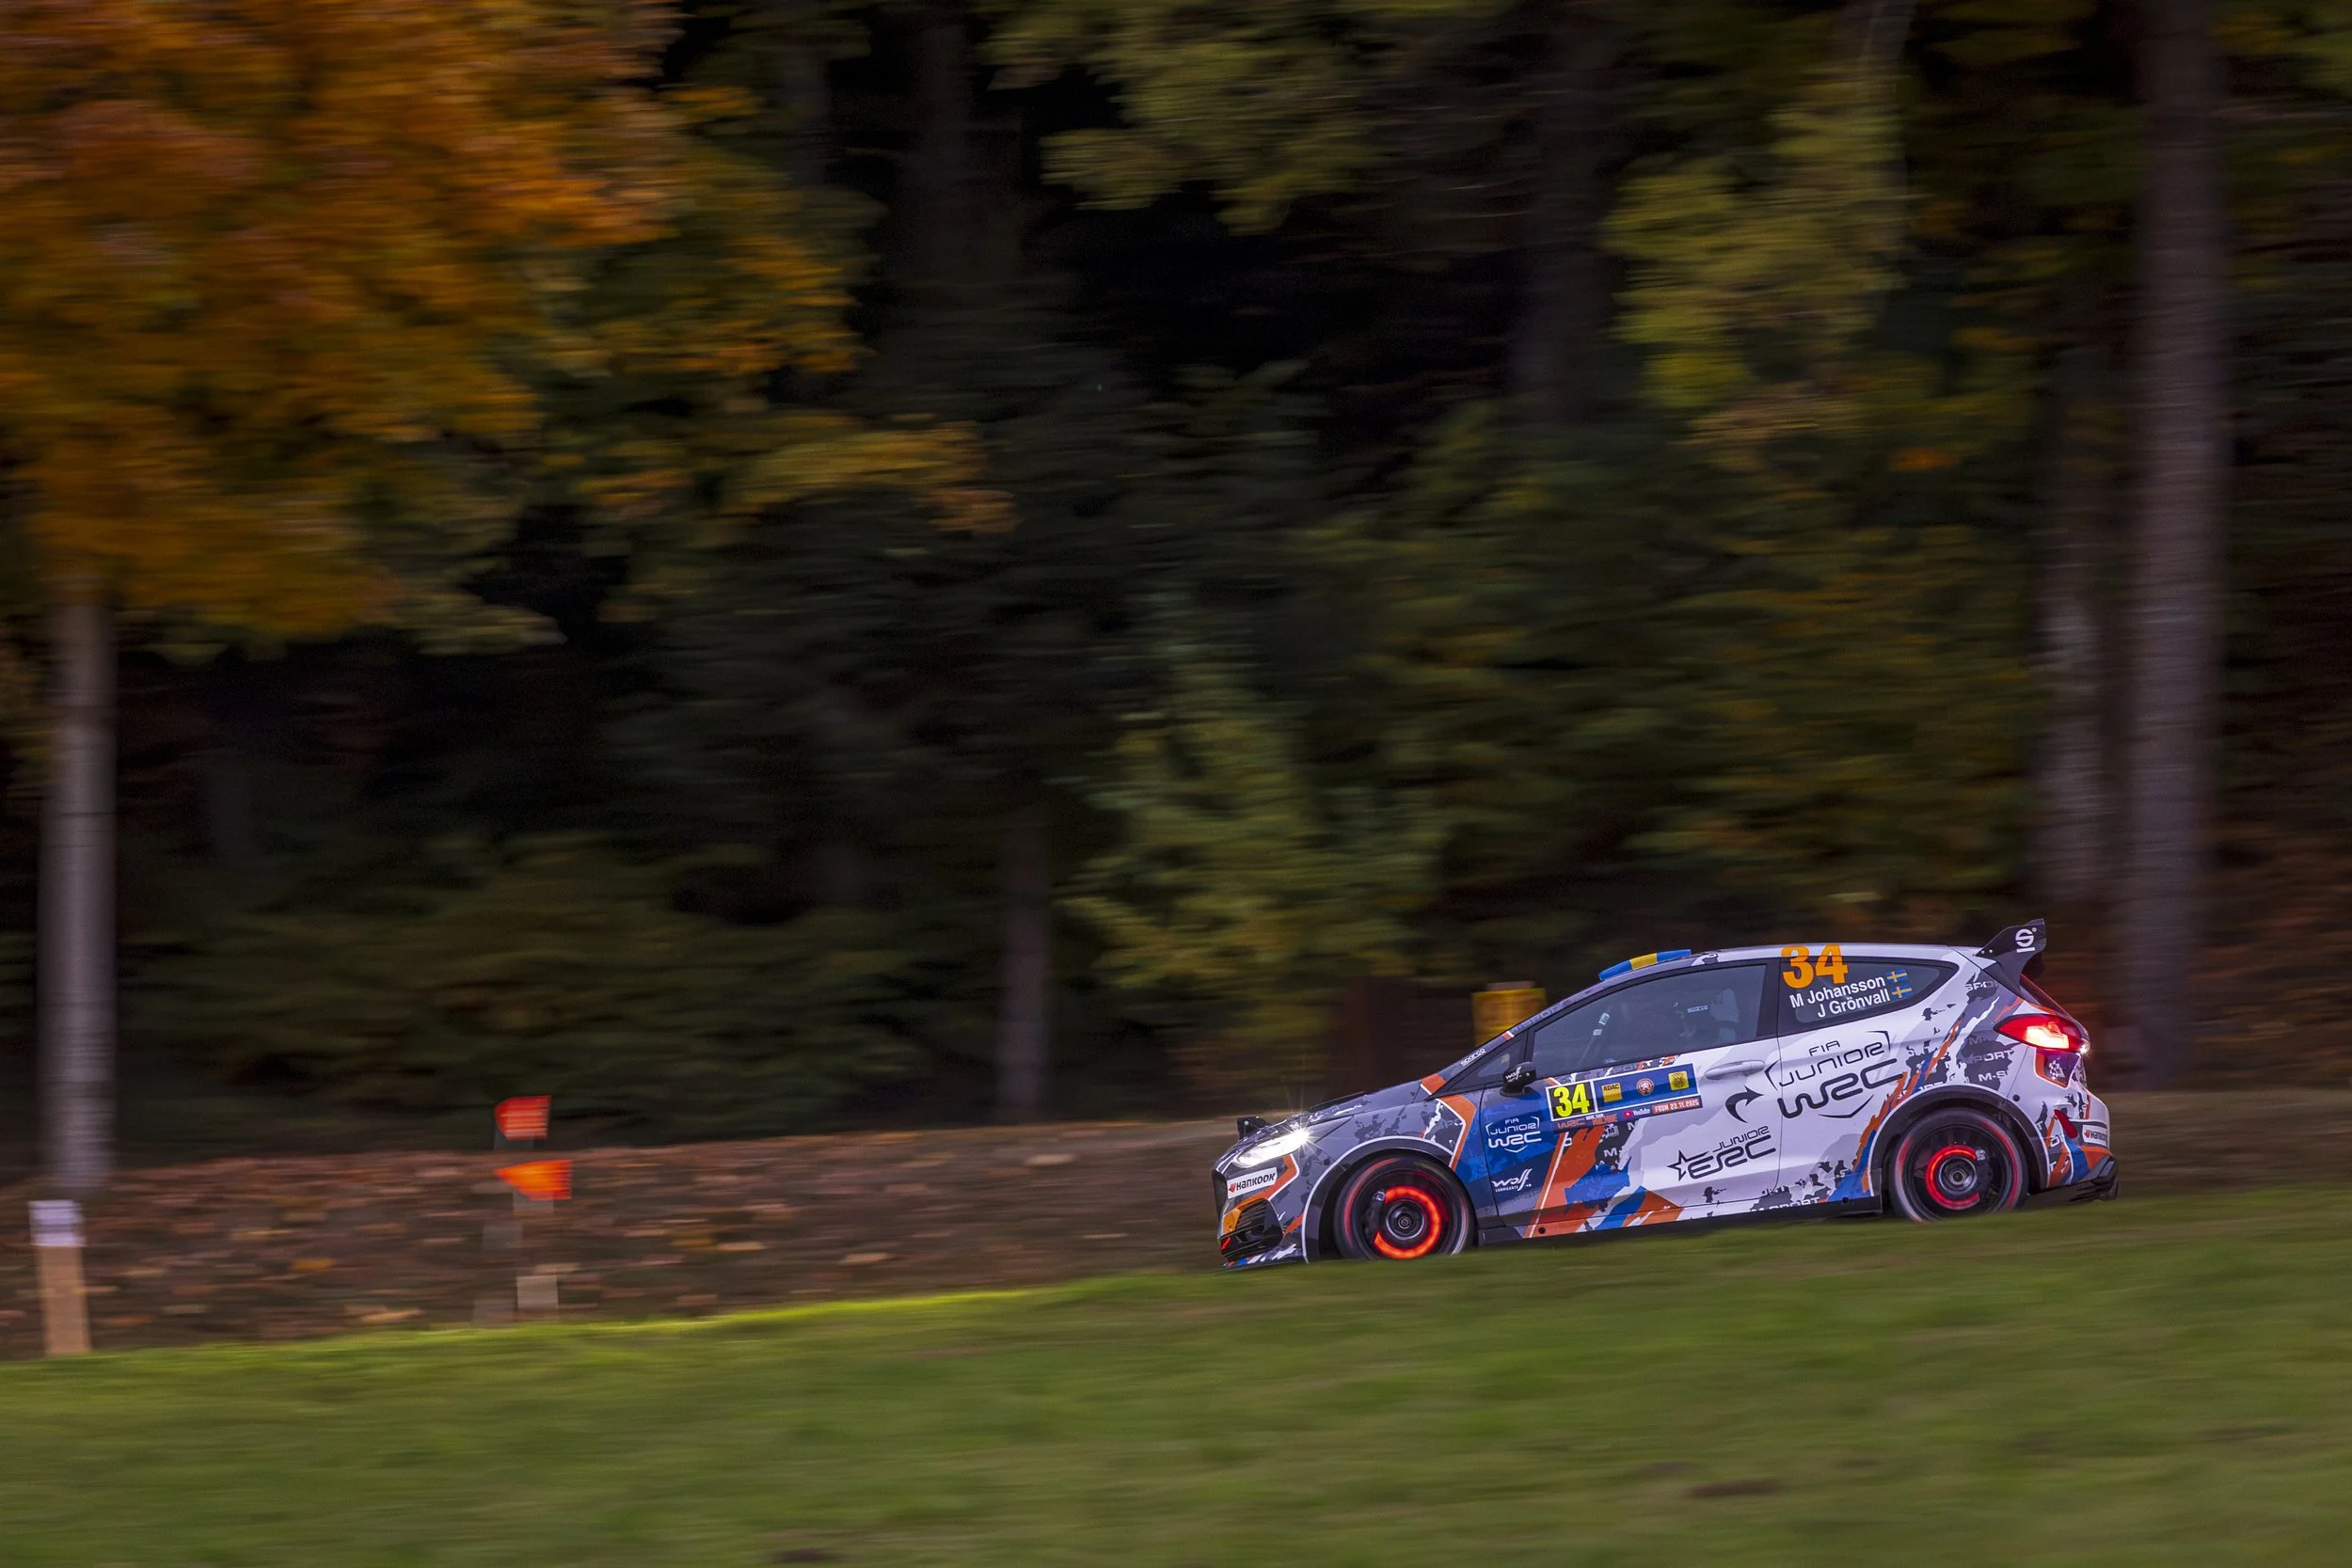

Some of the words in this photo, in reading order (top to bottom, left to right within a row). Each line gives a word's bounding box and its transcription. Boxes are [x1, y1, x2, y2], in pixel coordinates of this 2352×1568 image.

[1781, 943, 1849, 989] 34
[1789, 993, 1804, 1008] M
[1807, 976, 1885, 1004] Johansson
[1818, 1004, 1826, 1018] J
[1829, 989, 1891, 1014] Grönvall
[1808, 1040, 1840, 1056] FIA
[1778, 1042, 1884, 1086] JUNIOR
[1553, 1083, 1590, 1117] 34
[1603, 1084, 1620, 1092] ADAC
[1777, 1058, 1903, 1118] WRC
[1490, 1122, 1536, 1135] JUNIOR
[1557, 1117, 1585, 1129] WRC
[1488, 1131, 1542, 1148] WRC
[1712, 1126, 1770, 1153] JUNIOR
[1687, 1134, 1777, 1180] ERC
